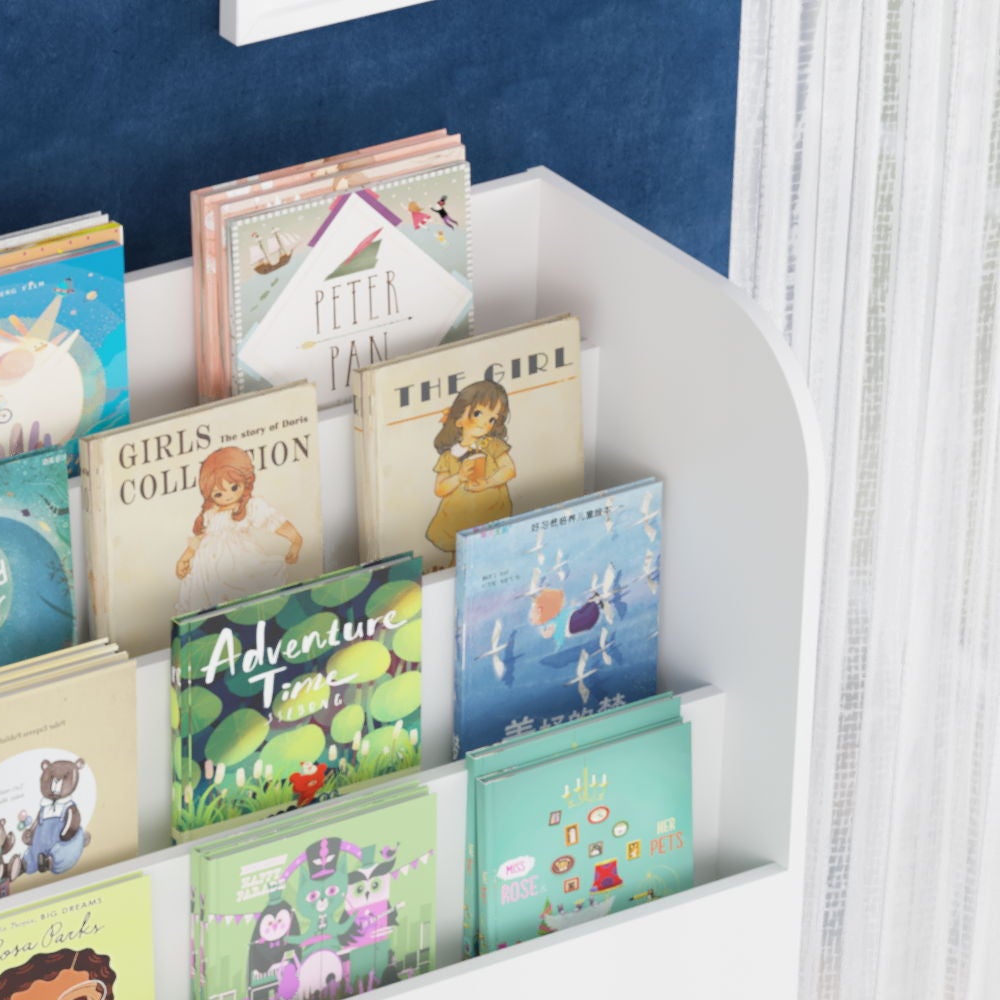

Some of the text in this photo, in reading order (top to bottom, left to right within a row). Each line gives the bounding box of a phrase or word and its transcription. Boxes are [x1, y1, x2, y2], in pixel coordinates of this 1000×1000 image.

[315, 270, 399, 334] PETER
[329, 331, 388, 391] PAN
[394, 371, 467, 408] THE
[484, 346, 574, 385] GIRL
[118, 415, 309, 471] GIRLS The story of Doris
[119, 433, 312, 506] COLLION
[200, 609, 408, 685] Adventure
[248, 665, 359, 709] Time
[650, 831, 684, 857] PETS
[656, 816, 676, 835] HER
[501, 875, 540, 906] ROSE
[505, 861, 526, 876] MISS
[40, 910, 58, 921] BIG
[62, 897, 104, 915] DREAMS
[41, 911, 105, 947] Parks
